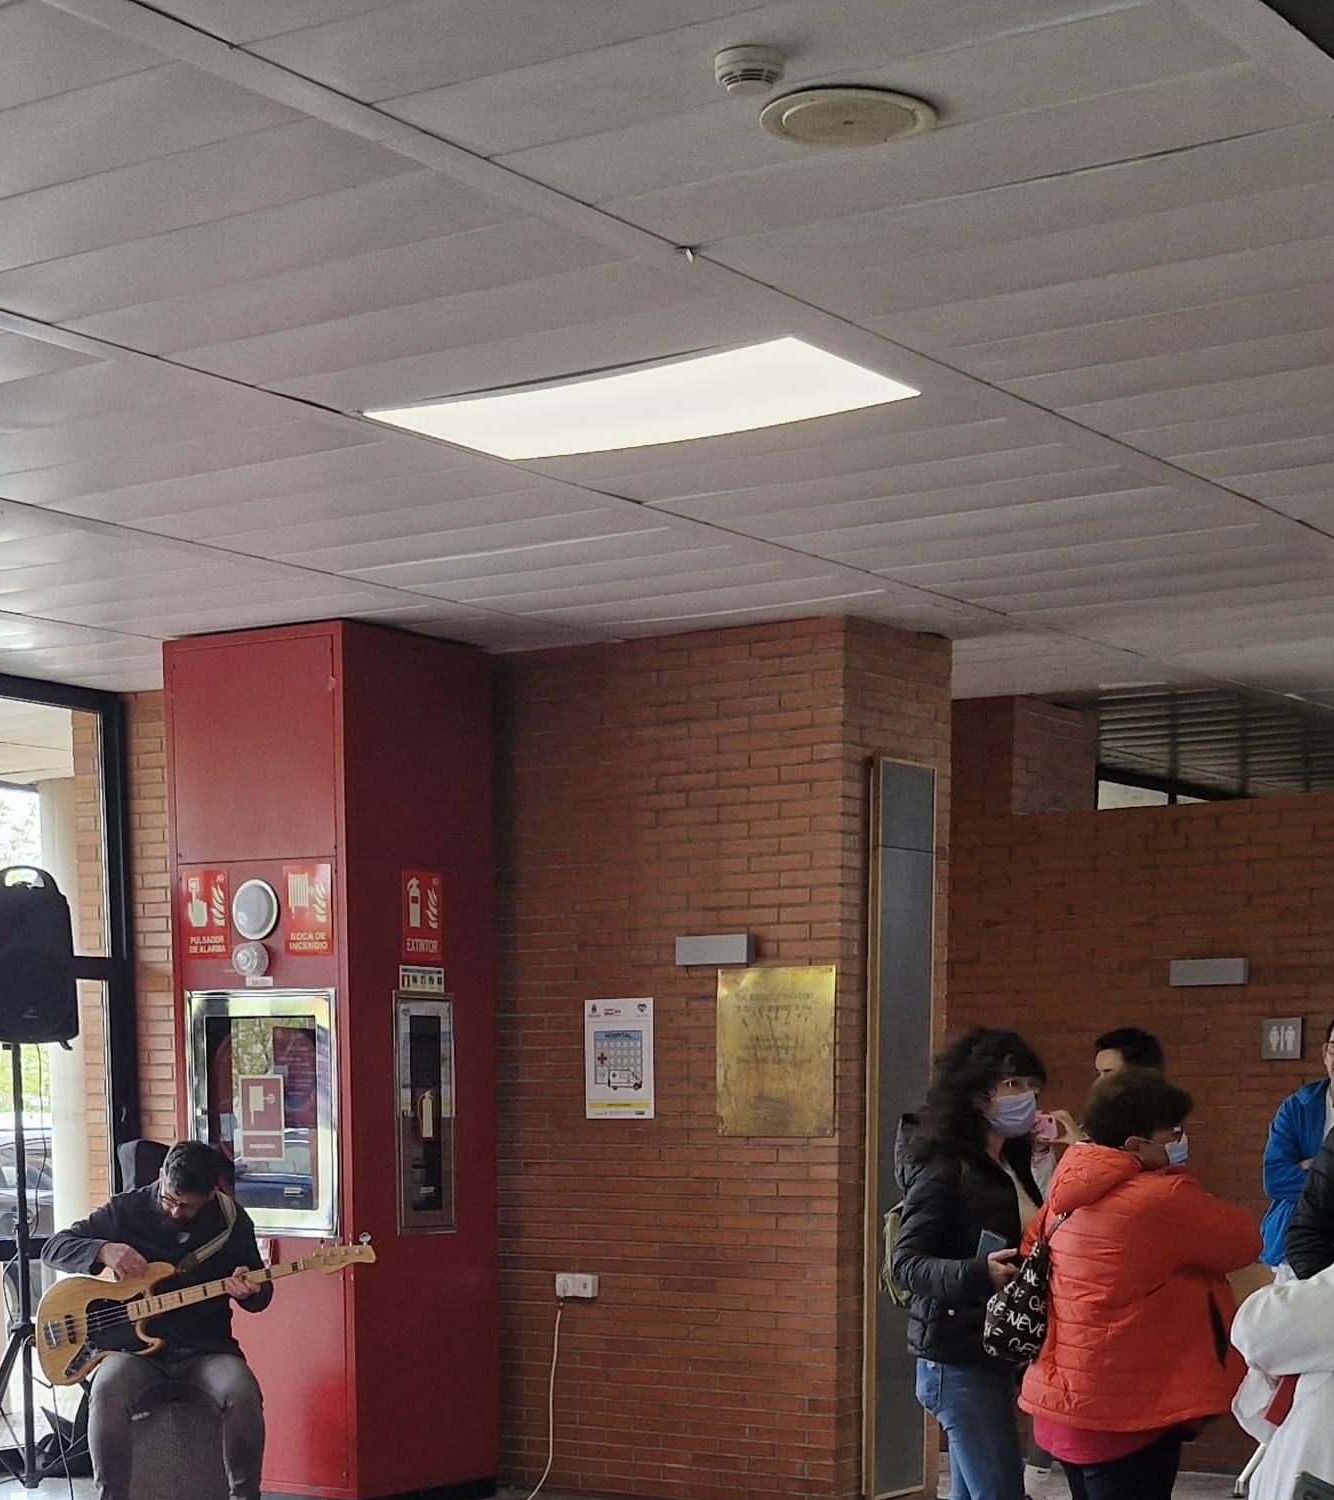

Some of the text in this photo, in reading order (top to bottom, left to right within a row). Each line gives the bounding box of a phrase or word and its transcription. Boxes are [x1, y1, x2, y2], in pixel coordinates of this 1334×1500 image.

[290, 931, 327, 941] BOCA DE
[199, 944, 226, 953] ALARMA
[289, 941, 328, 951] INCENDIO
[406, 937, 438, 953] EXTINTOR
